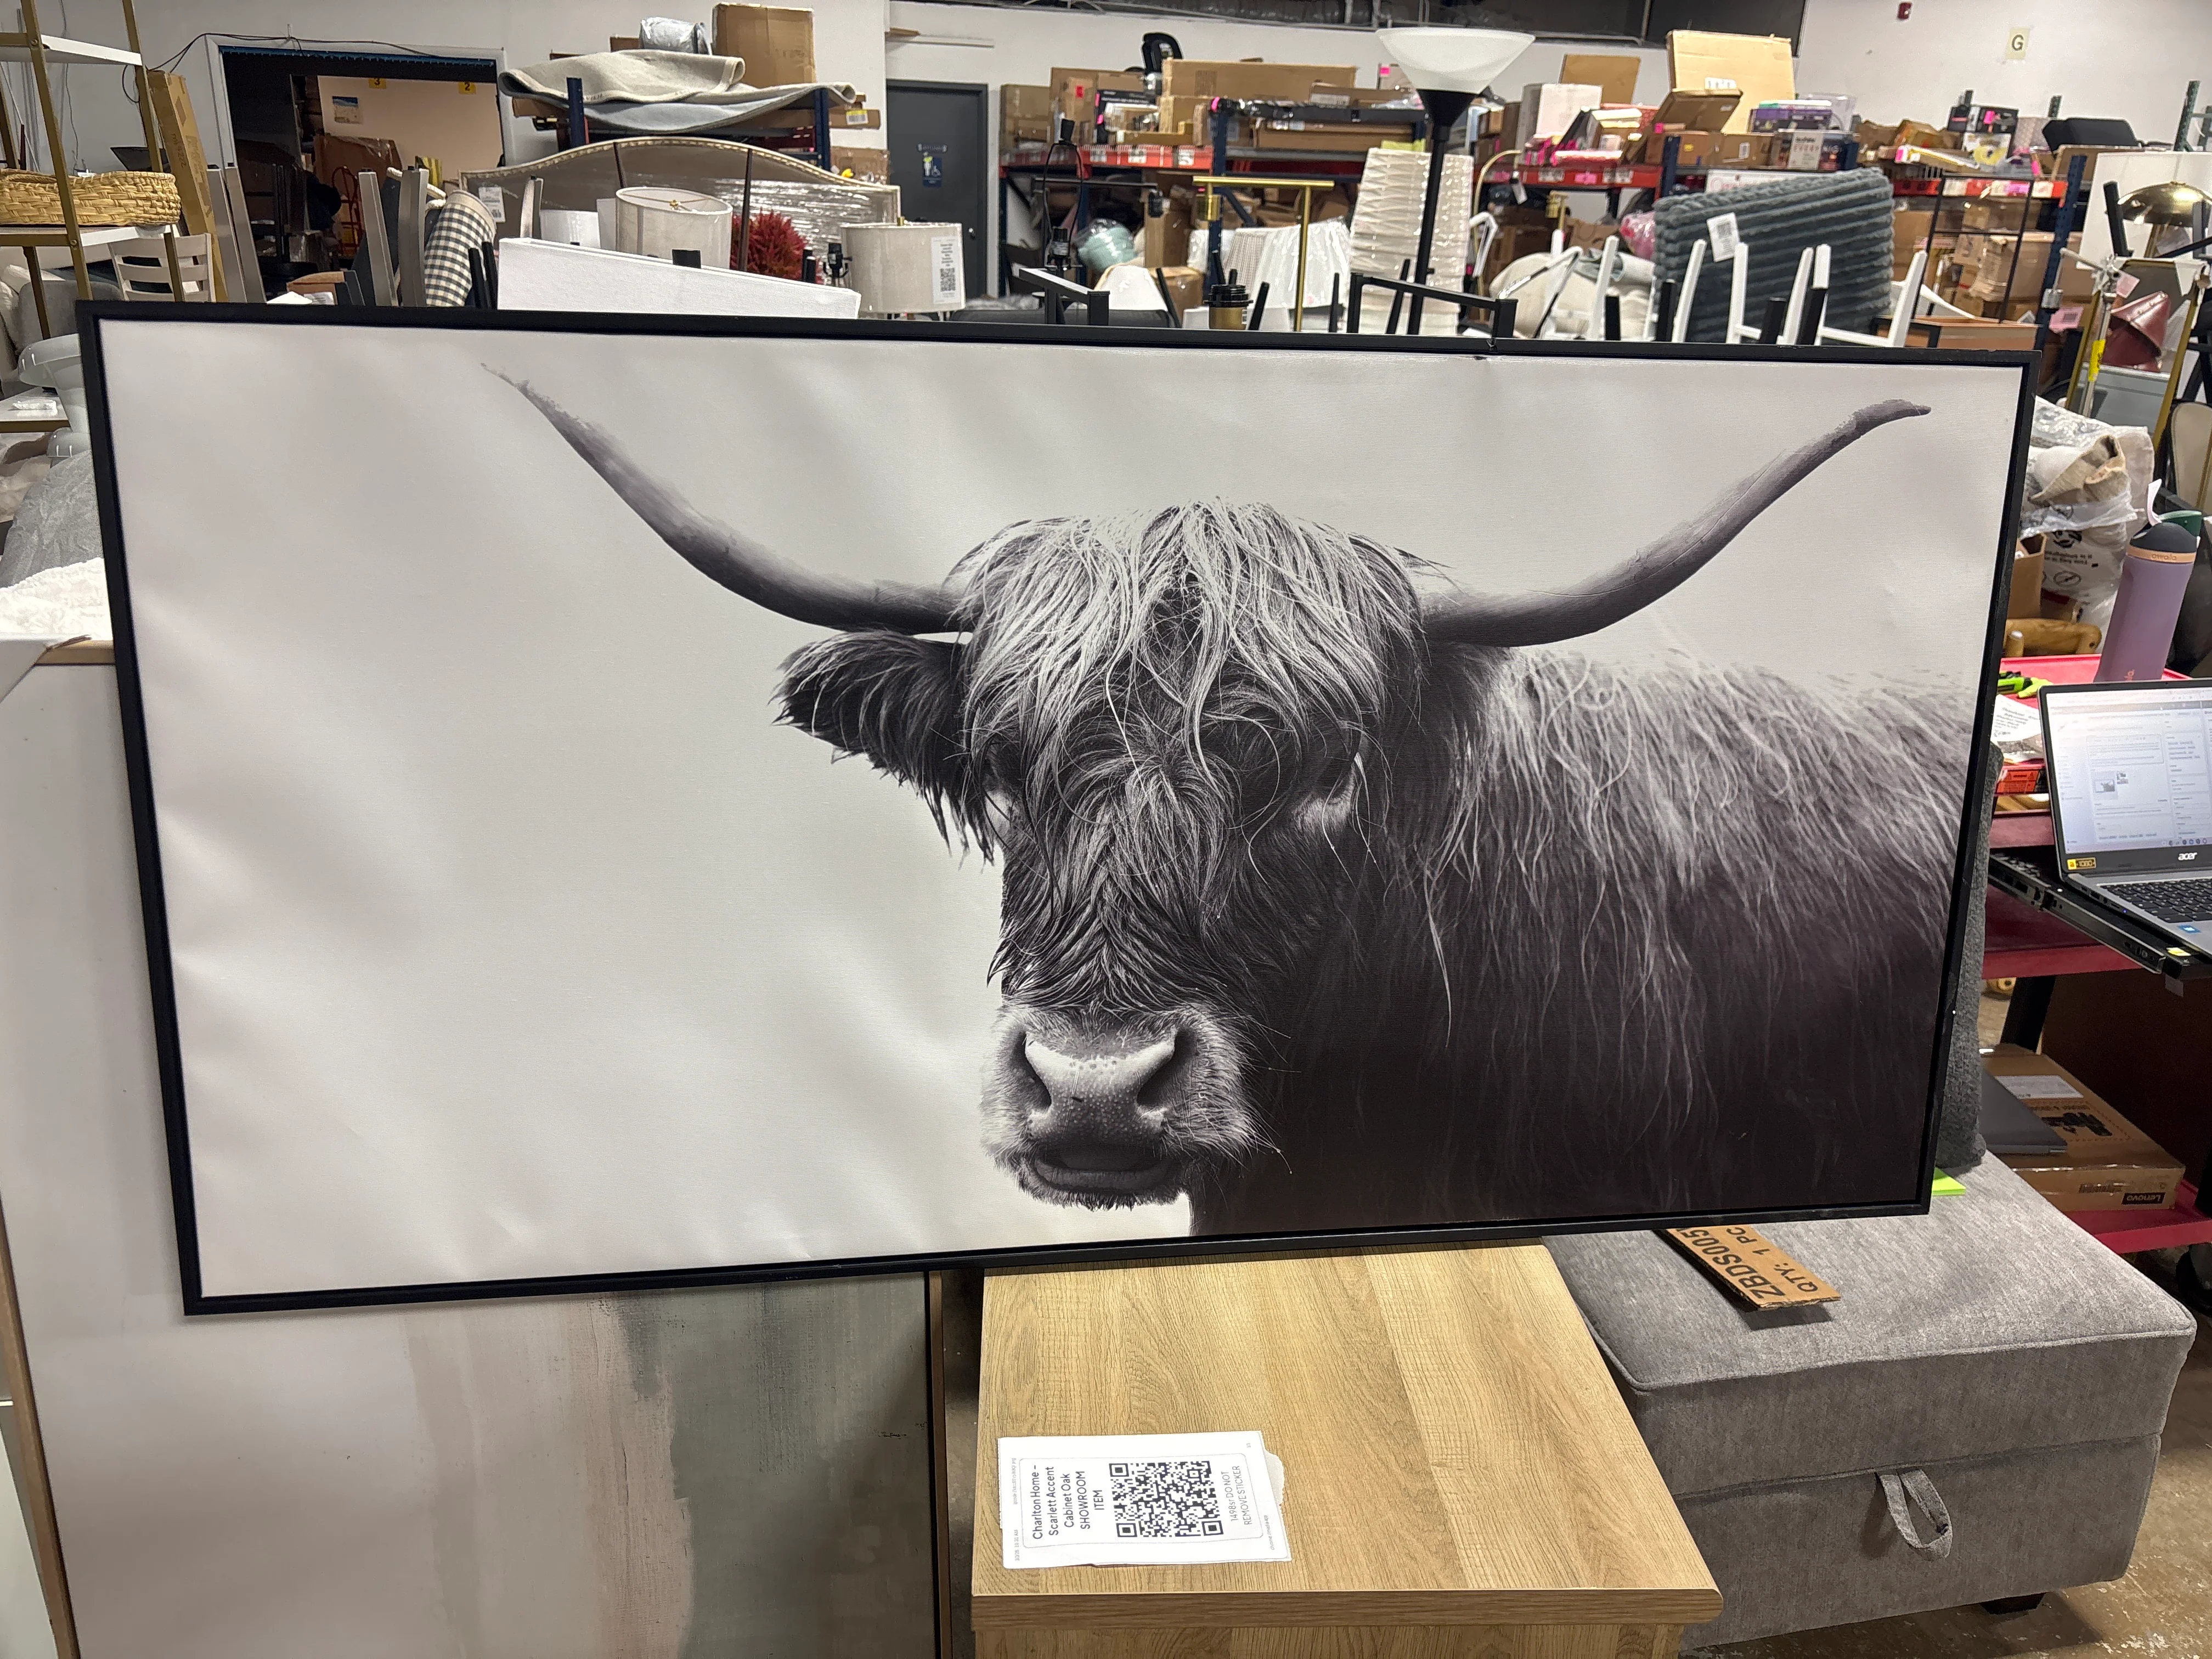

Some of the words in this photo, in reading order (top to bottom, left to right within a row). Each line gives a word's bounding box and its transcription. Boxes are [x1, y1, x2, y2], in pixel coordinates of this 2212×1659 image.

[2012, 34, 2024, 51] G
[464, 82, 471, 91] 2
[2177, 852, 2198, 861] acer
[1726, 1227, 1757, 1244] PC
[1774, 1262, 1819, 1292] QTY:
[1030, 1472, 1040, 1498] Home
[1045, 1466, 1056, 1498] Accent
[1060, 1473, 1071, 1491] Oak
[1221, 1471, 1231, 1486] NOT
[1232, 1465, 1245, 1494] STICKER
[1075, 1471, 1091, 1529] SHOWROOM
[1092, 1489, 1104, 1510] ITEM
[1224, 1487, 1234, 1498] DO
[1031, 1499, 1043, 1539] Charlton
[1047, 1499, 1059, 1536] Scarlett
[1063, 1493, 1074, 1527] Cabinet
[1238, 1495, 1252, 1525] REMOVE
